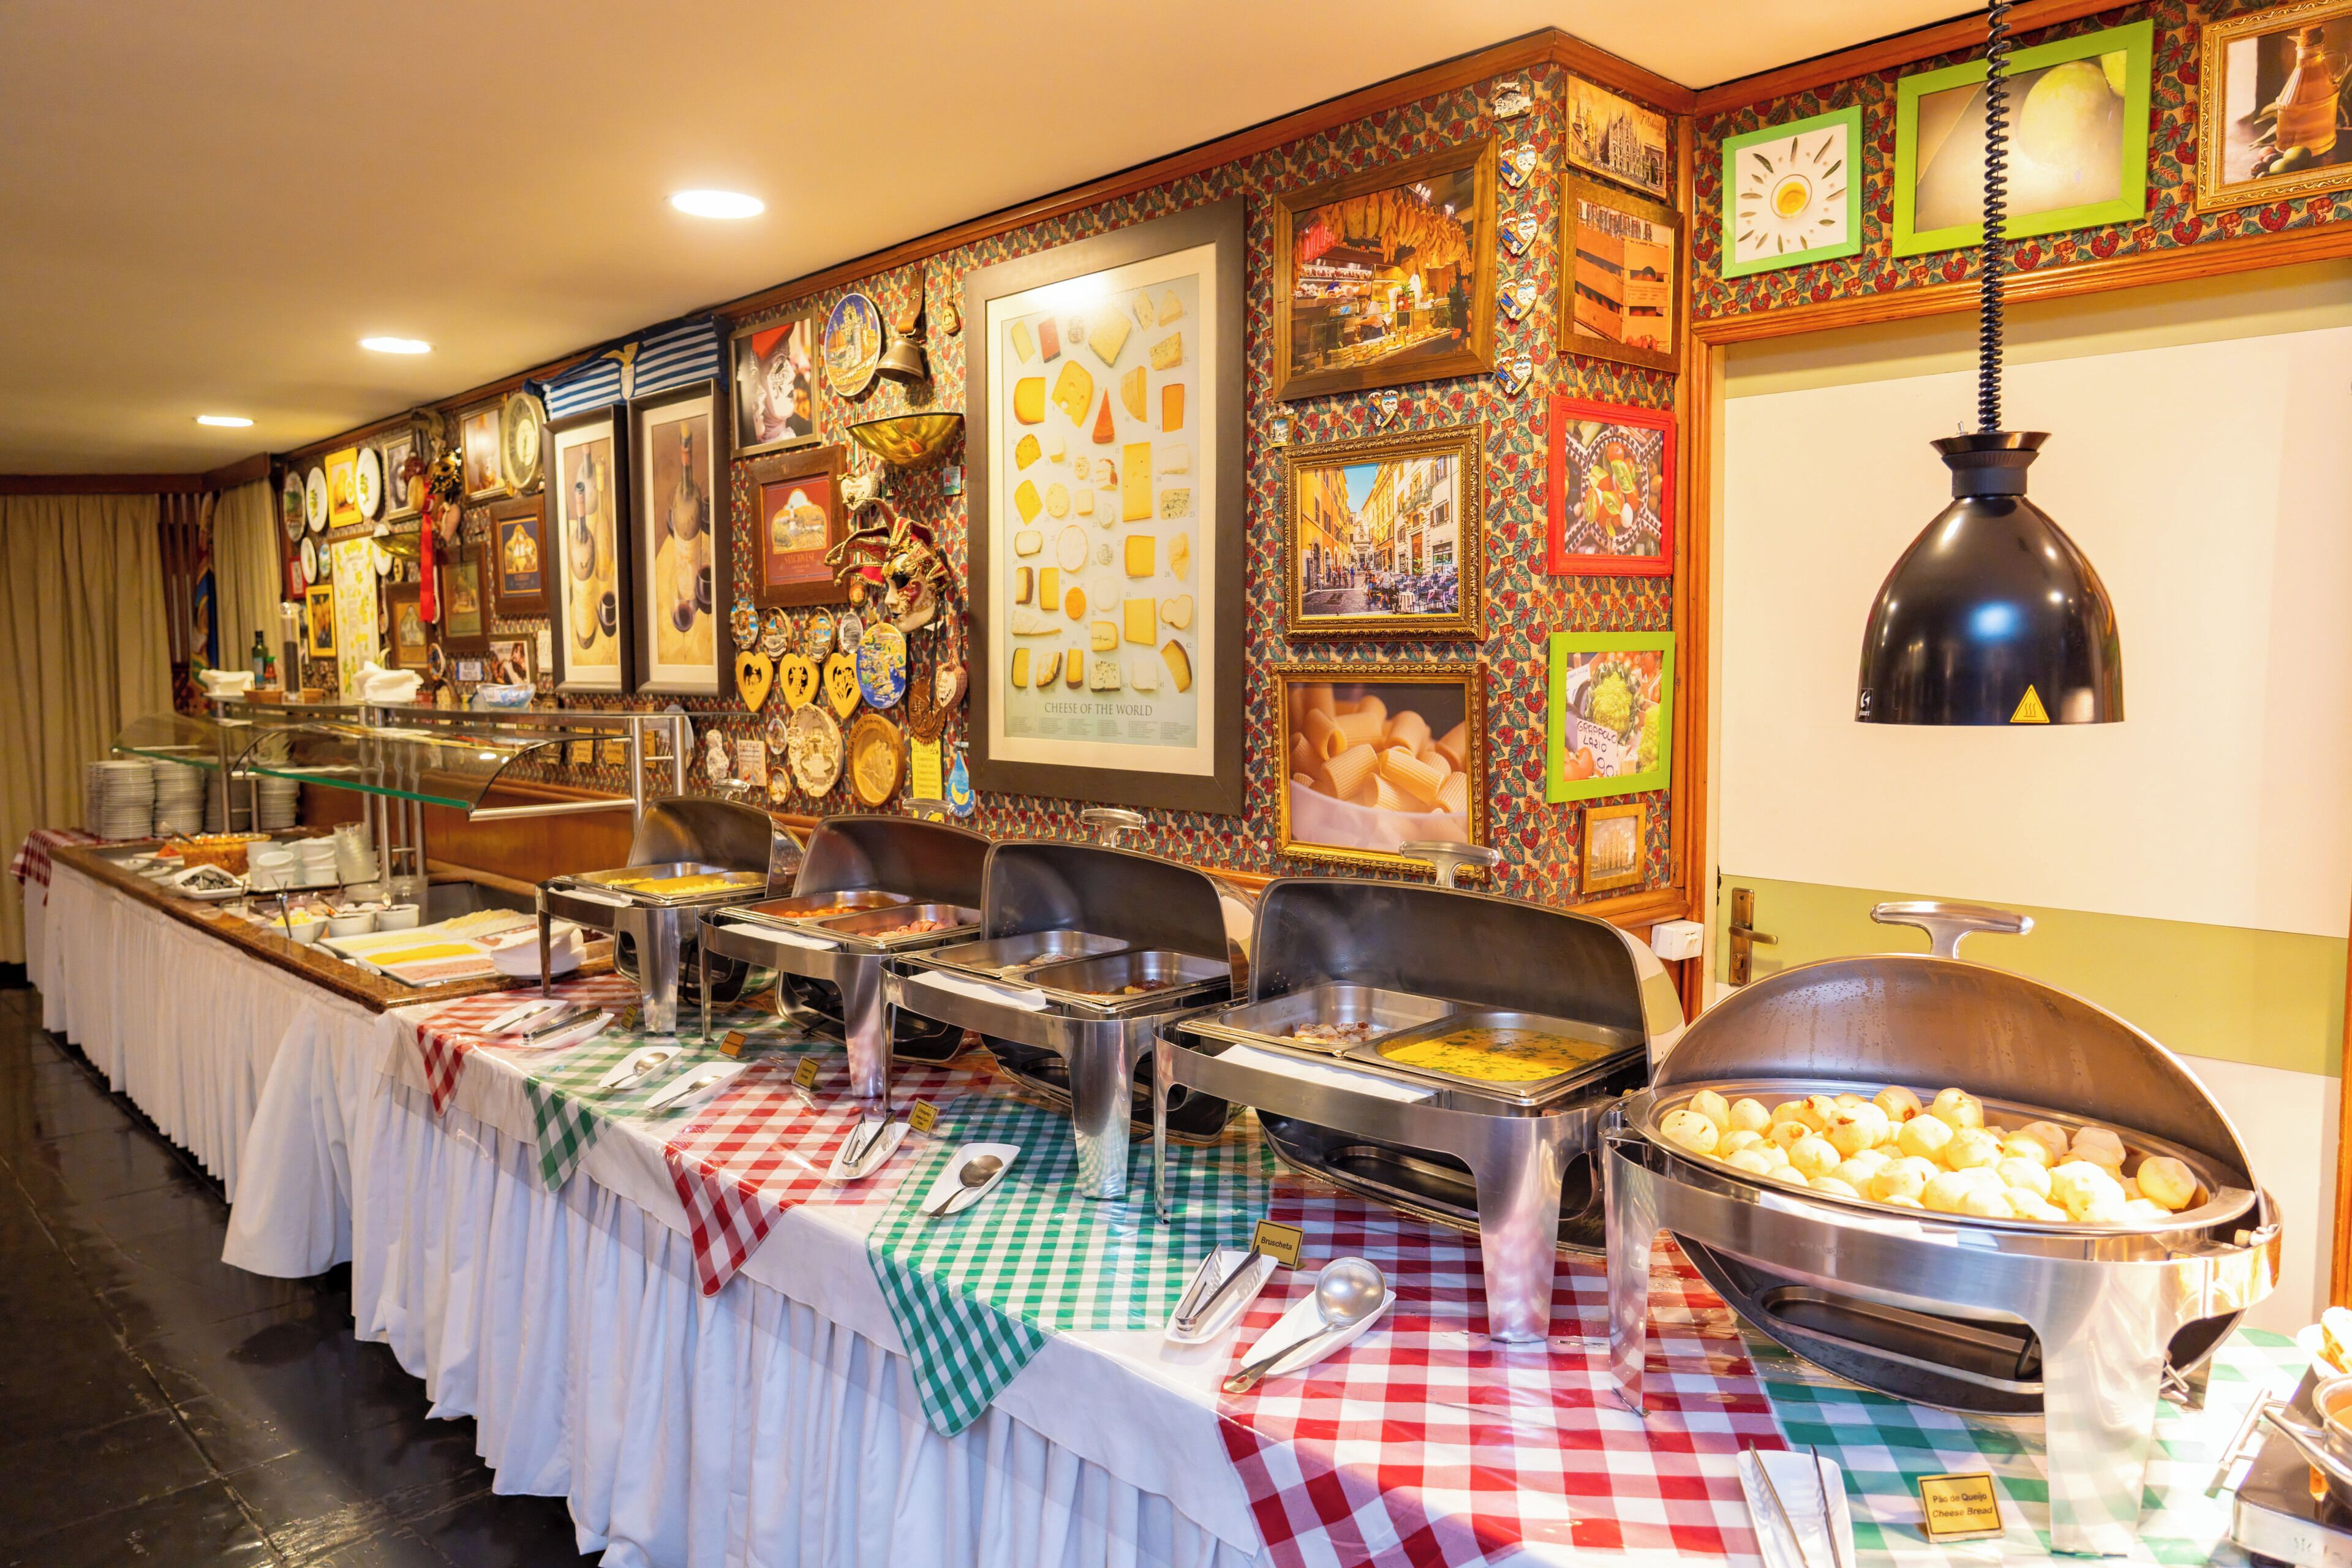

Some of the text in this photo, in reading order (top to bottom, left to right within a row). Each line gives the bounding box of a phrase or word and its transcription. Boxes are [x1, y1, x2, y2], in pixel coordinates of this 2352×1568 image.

[1044, 702, 1153, 716] CHEESE OF THE WORLD
[1577, 720, 1618, 744] GRAPPOLO
[1261, 1236, 1292, 1251] Bruscheta
[1932, 1494, 1948, 1503] Pão
[1961, 1493, 1987, 1502] Queijo
[1932, 1506, 1992, 1518] Cheese Bread
